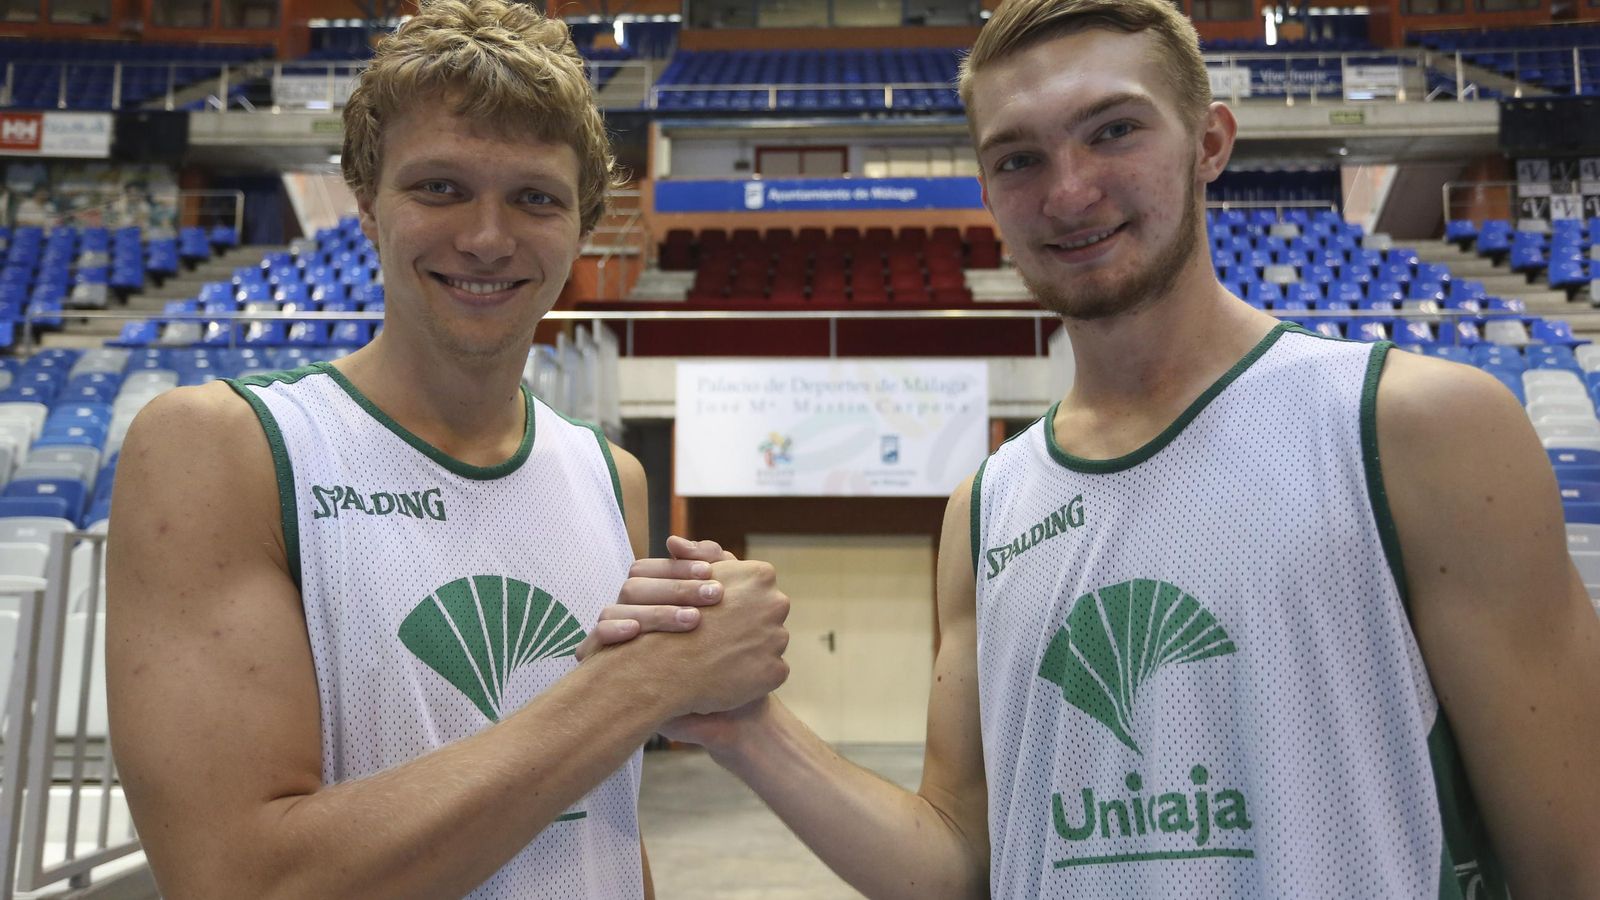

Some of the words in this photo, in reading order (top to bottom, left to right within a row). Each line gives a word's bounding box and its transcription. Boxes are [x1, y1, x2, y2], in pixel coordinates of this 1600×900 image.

[768, 187, 850, 203] Ayuntamiento
[852, 188, 869, 200] de
[697, 376, 761, 393] Palacio
[764, 377, 785, 393] de
[790, 376, 871, 397] Deportes
[874, 377, 896, 393] de
[875, 399, 970, 417] Carpena
[312, 485, 447, 521] SPALDING
[986, 494, 1085, 581] SPALDING
